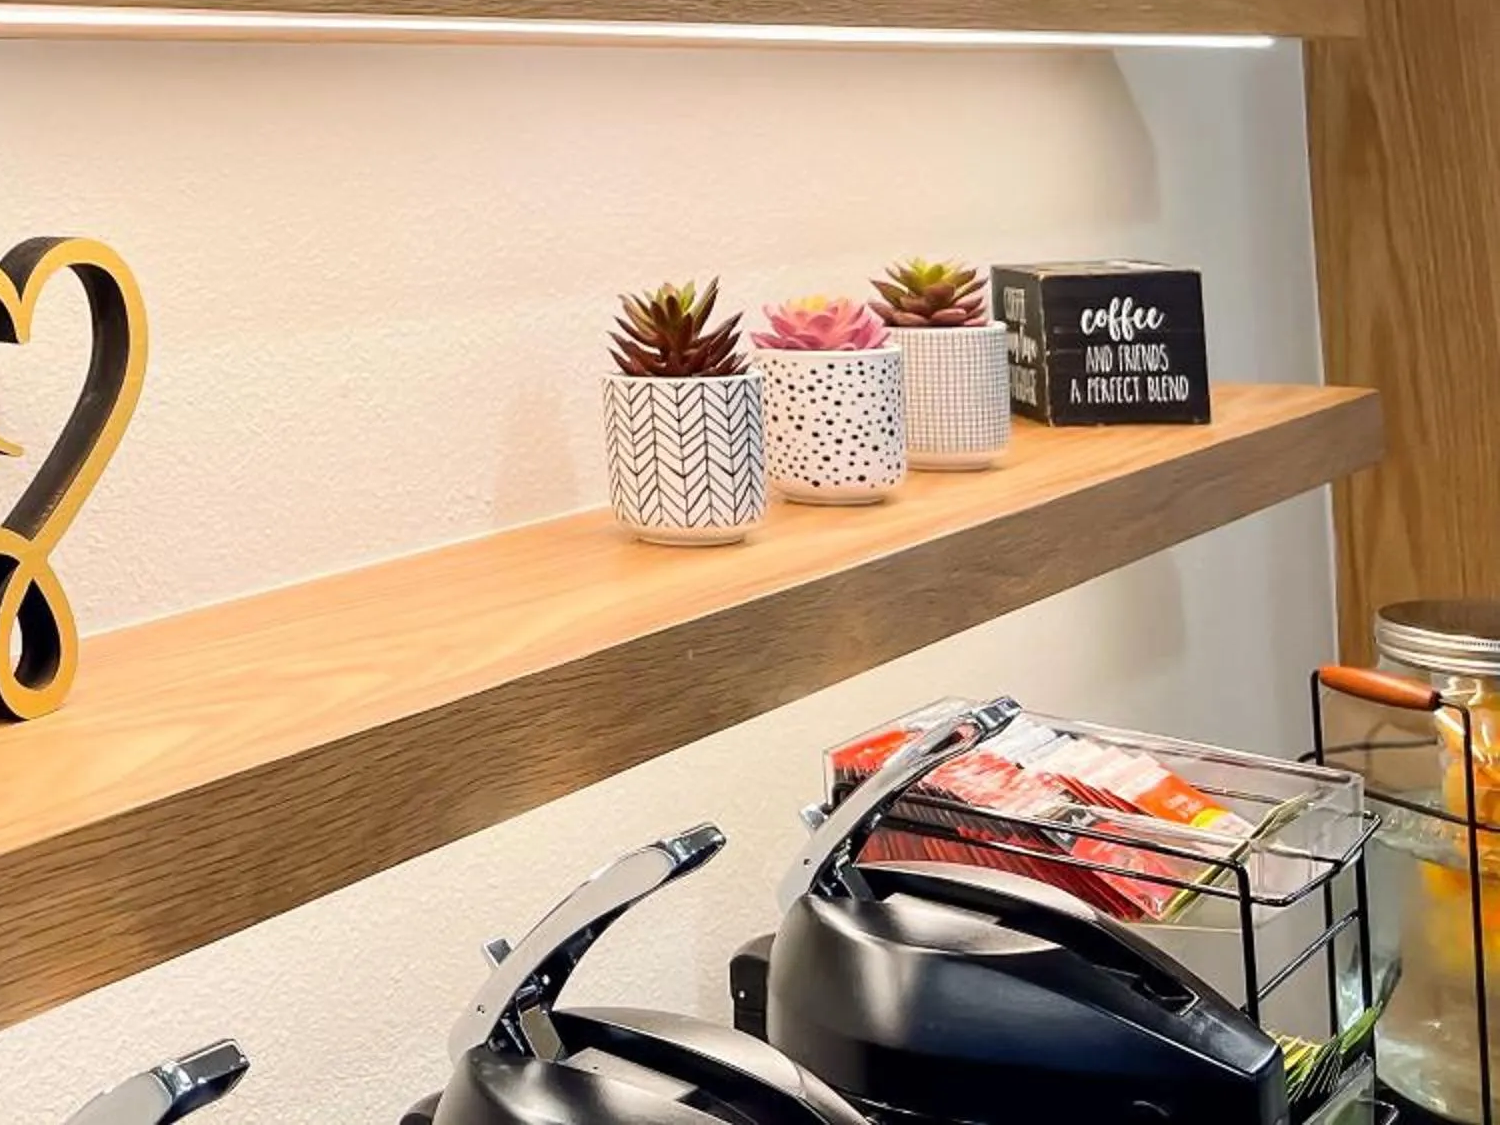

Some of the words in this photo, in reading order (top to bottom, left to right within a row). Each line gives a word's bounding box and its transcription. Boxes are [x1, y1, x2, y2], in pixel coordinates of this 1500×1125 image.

[1080, 296, 1165, 341] coffee
[1085, 346, 1113, 373] AND
[1118, 344, 1170, 372] FRIENDS
[1070, 379, 1082, 404] A
[1087, 376, 1140, 404] PERFECT
[1147, 374, 1190, 403] BLEND
